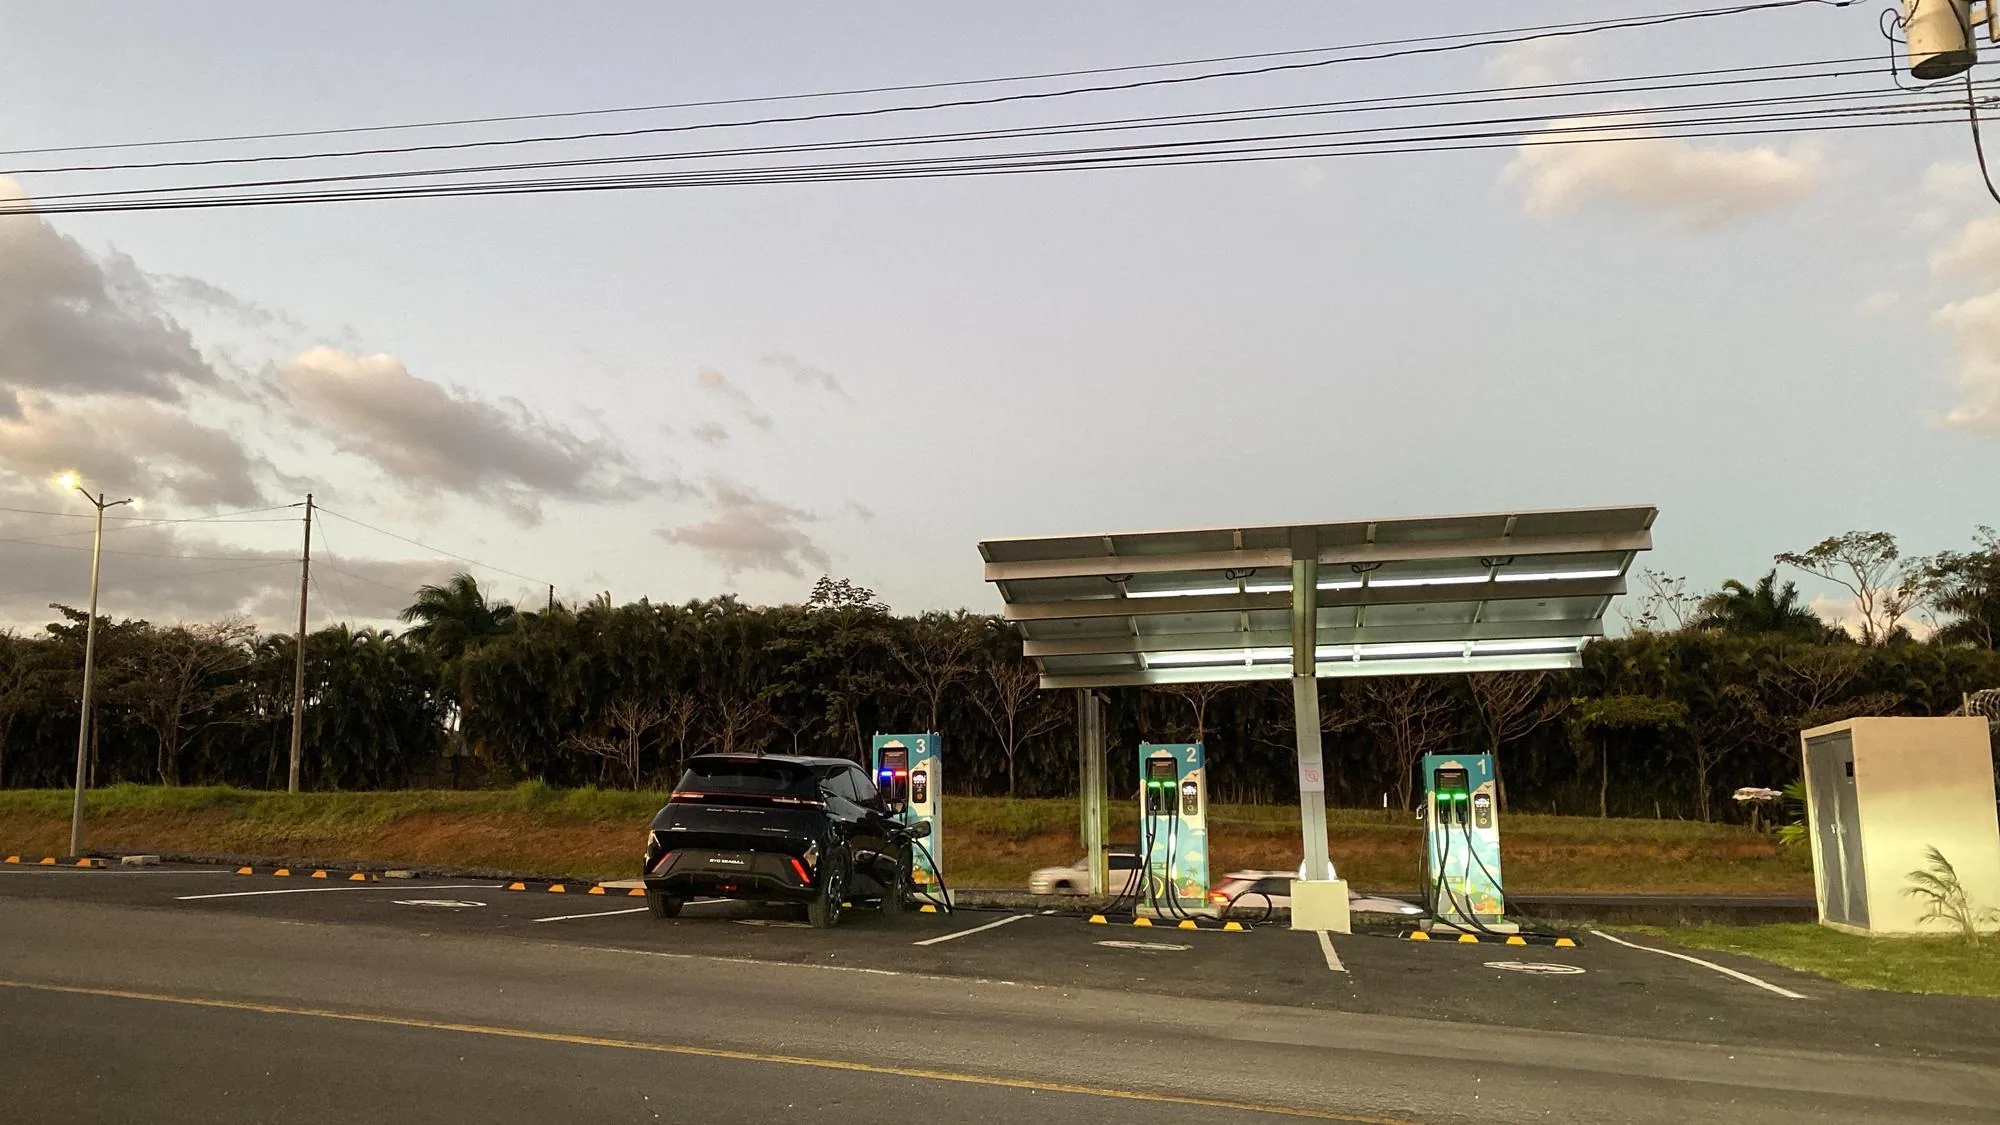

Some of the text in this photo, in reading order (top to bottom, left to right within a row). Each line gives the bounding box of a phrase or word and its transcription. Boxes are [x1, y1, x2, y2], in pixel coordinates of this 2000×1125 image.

[916, 738, 926, 753] 3
[1186, 747, 1197, 762] 2
[1477, 759, 1486, 775] 1
